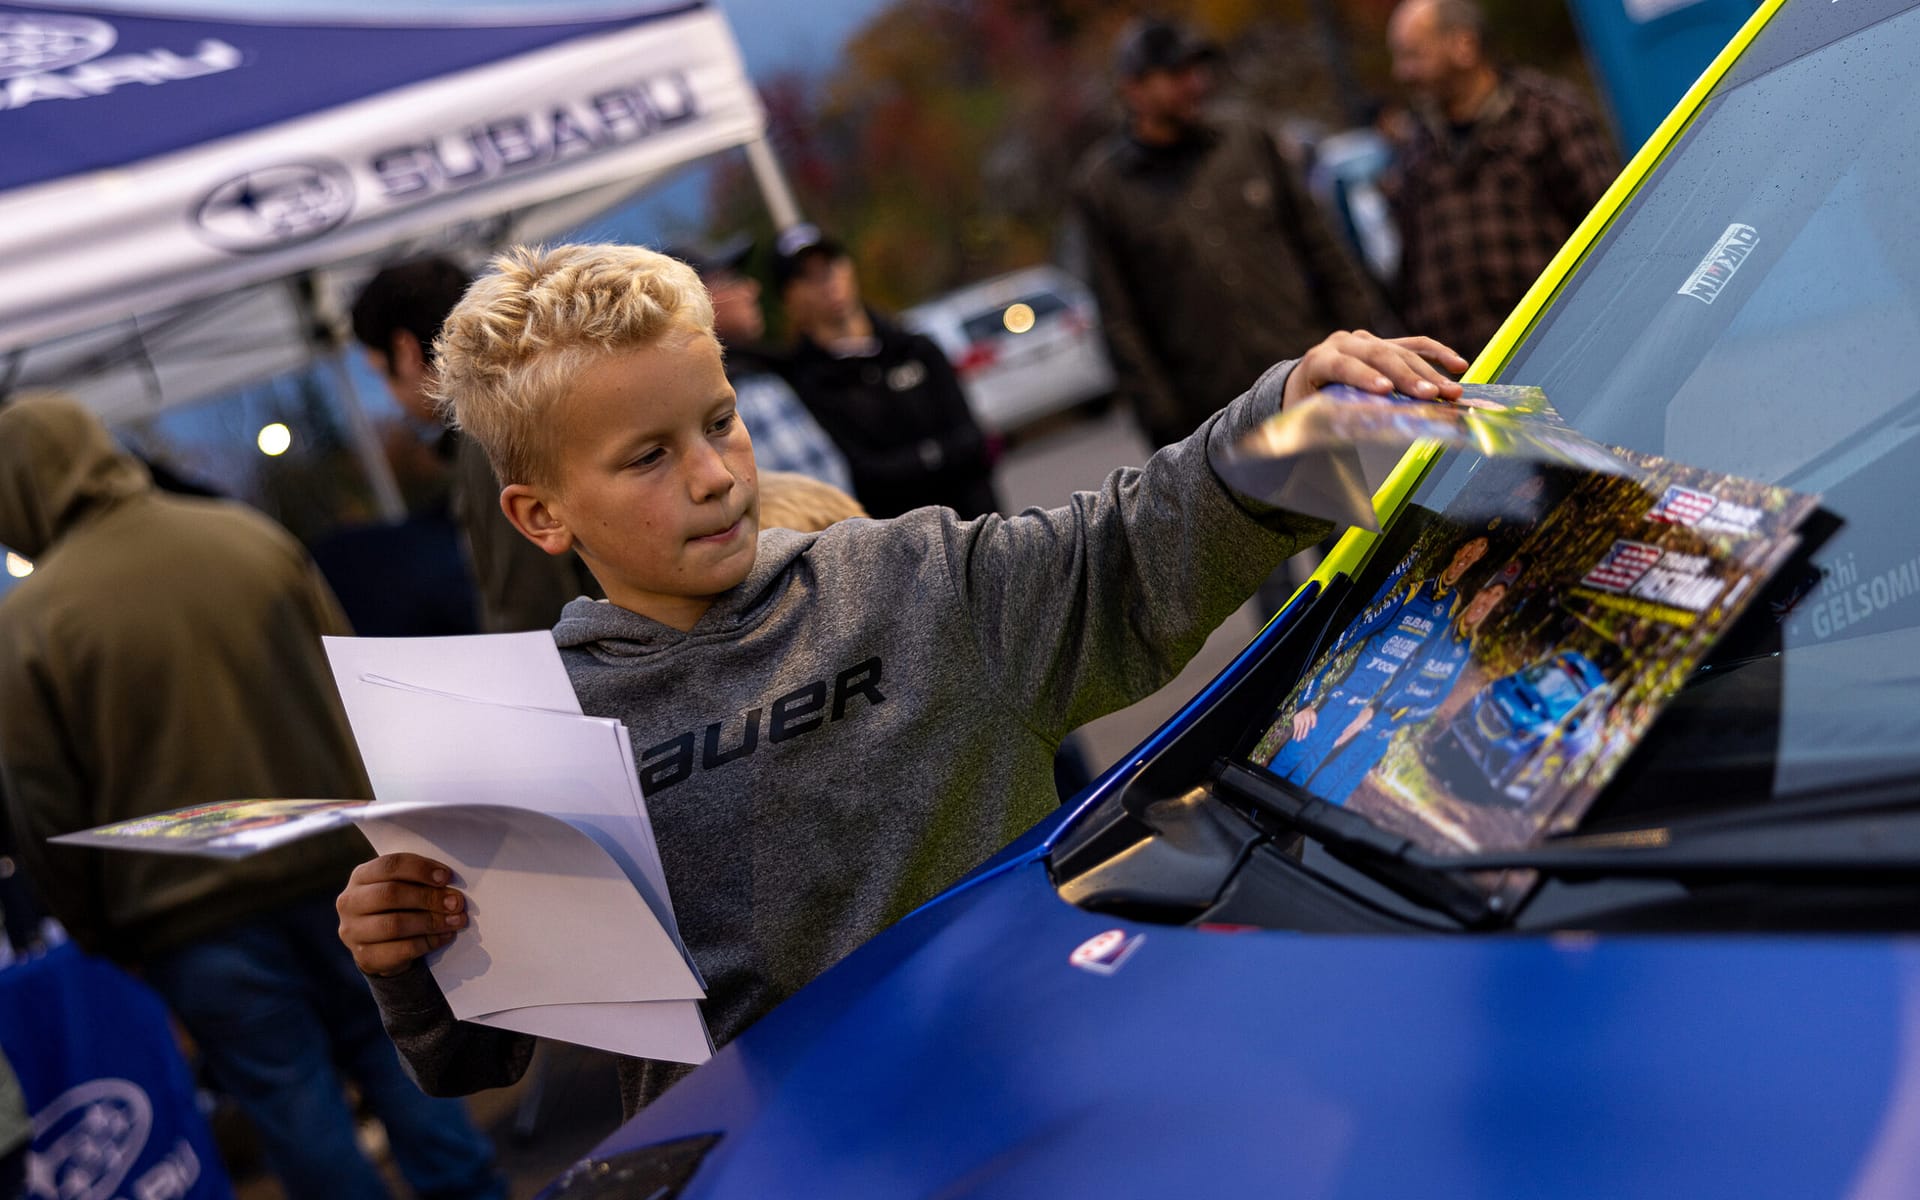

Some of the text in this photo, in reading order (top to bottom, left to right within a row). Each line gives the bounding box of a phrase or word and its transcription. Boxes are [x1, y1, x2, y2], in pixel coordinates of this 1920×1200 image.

[371, 72, 700, 197] SUBARU
[1811, 554, 1920, 638] GELSOMI
[1822, 552, 1858, 597] Rhi
[640, 656, 887, 797] aueR
